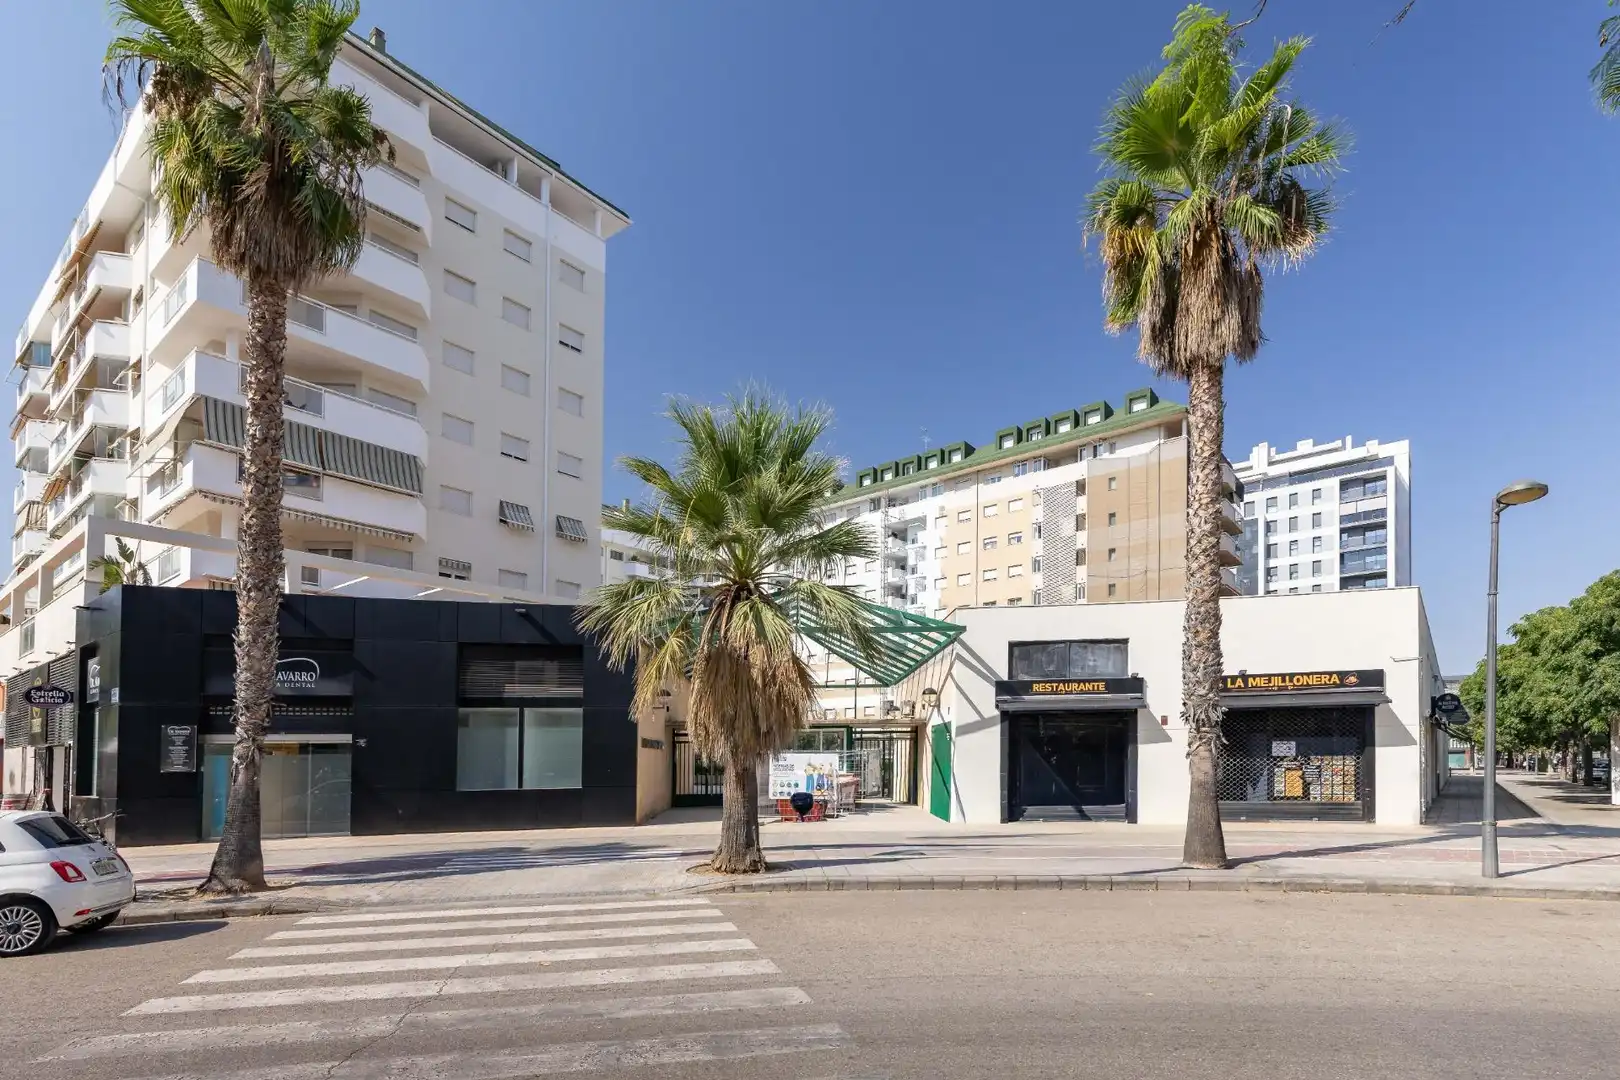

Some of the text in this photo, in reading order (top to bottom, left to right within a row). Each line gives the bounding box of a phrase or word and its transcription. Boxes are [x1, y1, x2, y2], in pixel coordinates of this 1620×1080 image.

[275, 671, 316, 682] AVARRO
[1227, 673, 1340, 688] LA MEJILLONERA
[1032, 682, 1106, 692] RESTAURANTE
[29, 689, 65, 698] Estrella
